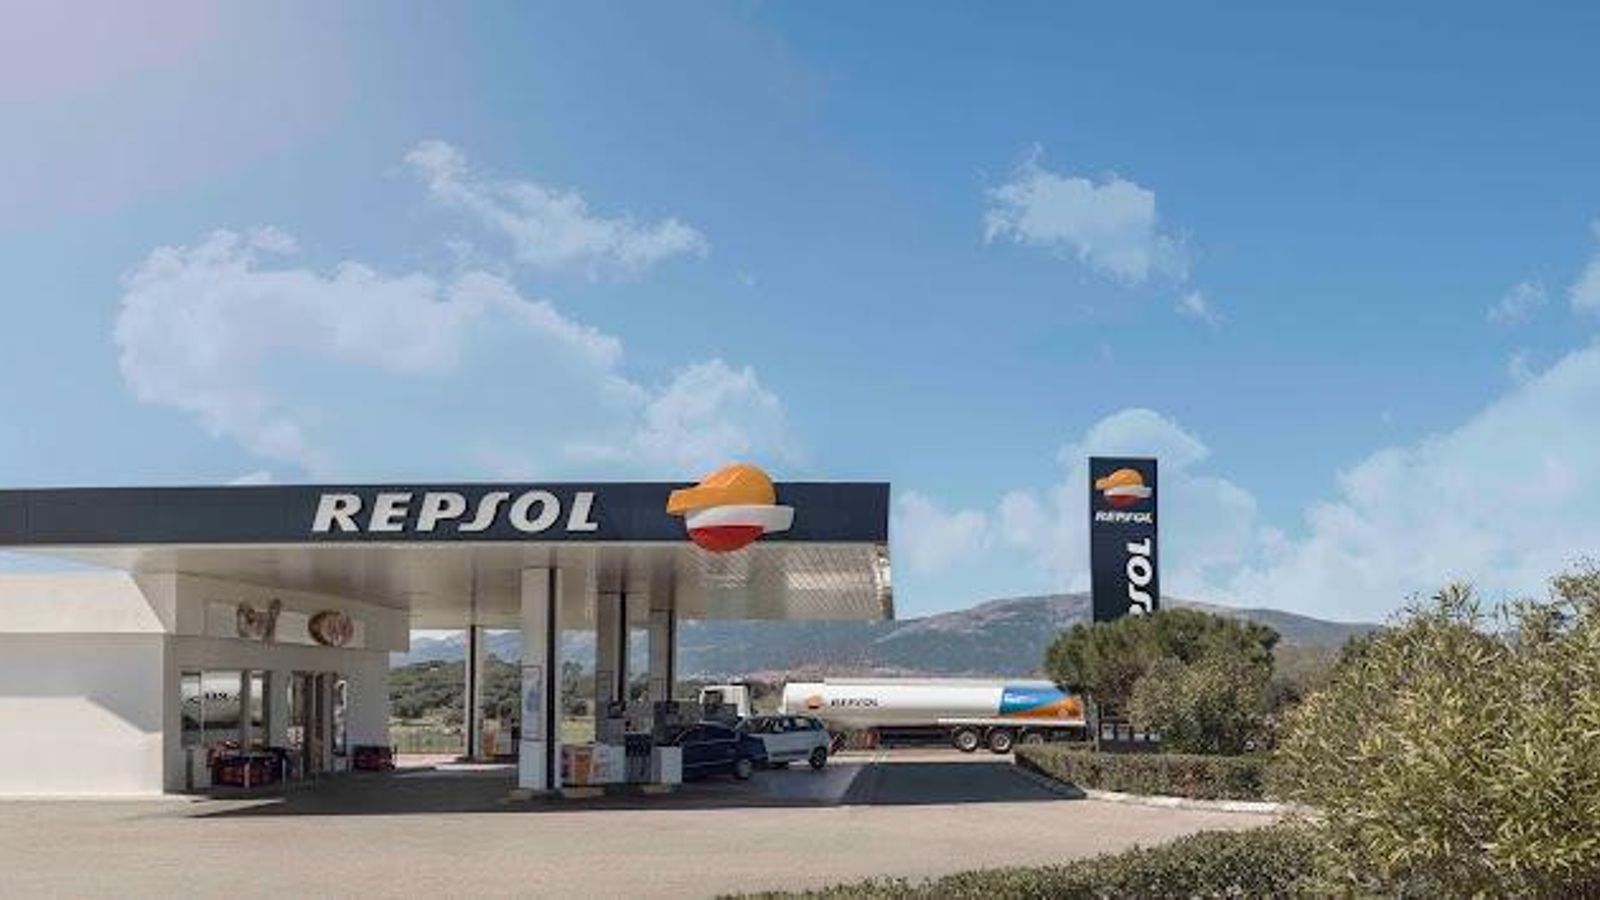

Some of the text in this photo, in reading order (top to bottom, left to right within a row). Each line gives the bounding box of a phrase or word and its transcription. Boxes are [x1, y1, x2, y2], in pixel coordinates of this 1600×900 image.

[312, 490, 599, 532] REPSOL
[1095, 511, 1153, 523] REPSOL
[830, 698, 879, 707] REPSOL
